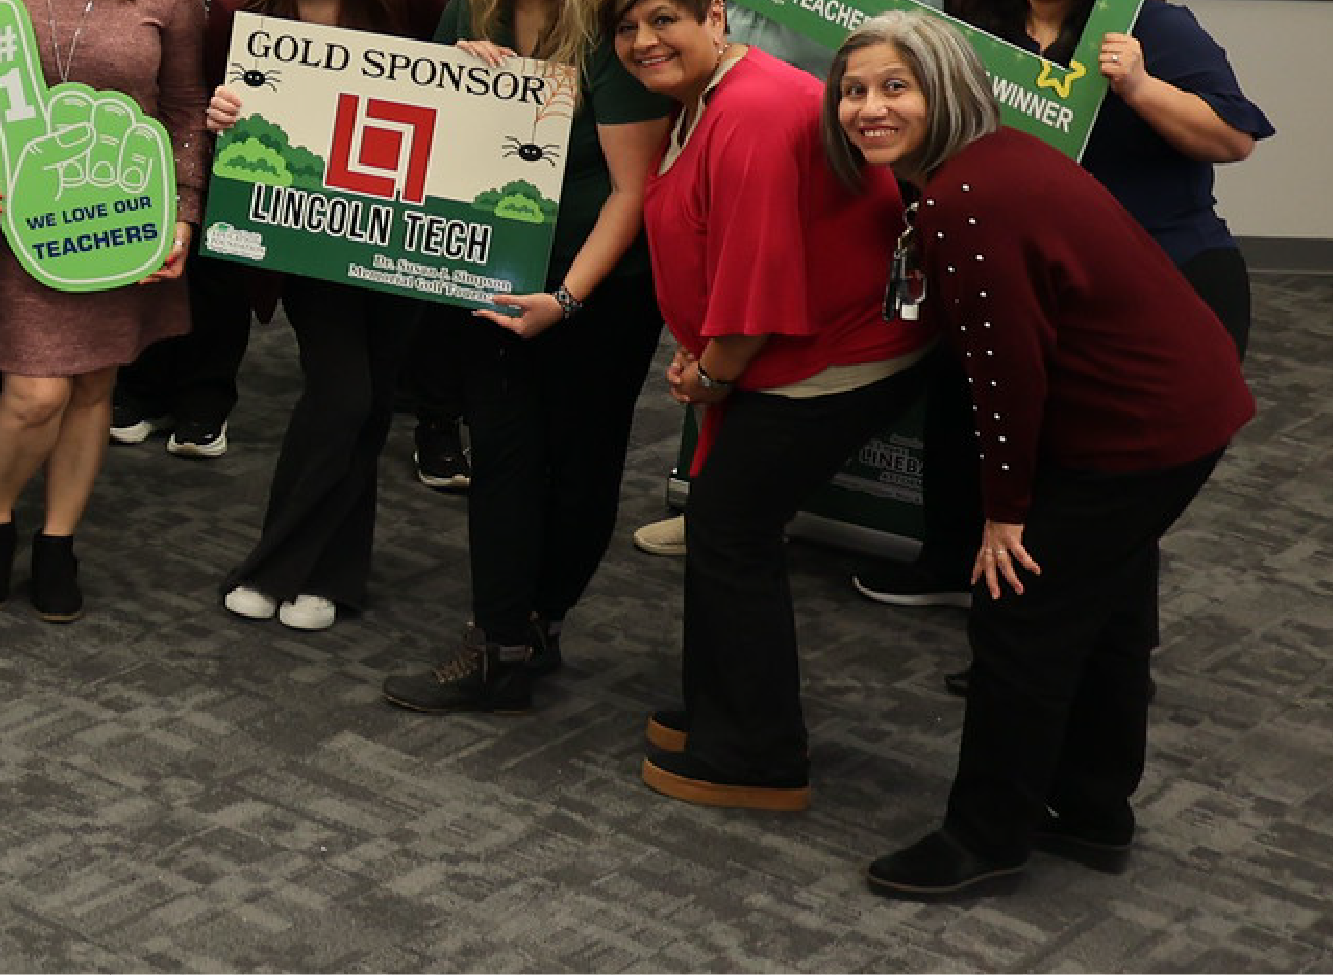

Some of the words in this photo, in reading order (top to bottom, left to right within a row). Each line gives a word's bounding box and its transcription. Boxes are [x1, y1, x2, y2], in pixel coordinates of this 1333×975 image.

[246, 29, 351, 72] GOLD
[361, 48, 546, 106] SPONSOR
[992, 75, 1075, 133] WINNER
[25, 212, 58, 231] WE
[61, 202, 108, 225] LOVE
[113, 195, 153, 214] OUR
[31, 223, 159, 261] TEACHERS
[248, 181, 394, 247] LINCOLN
[402, 210, 493, 265] TECH
